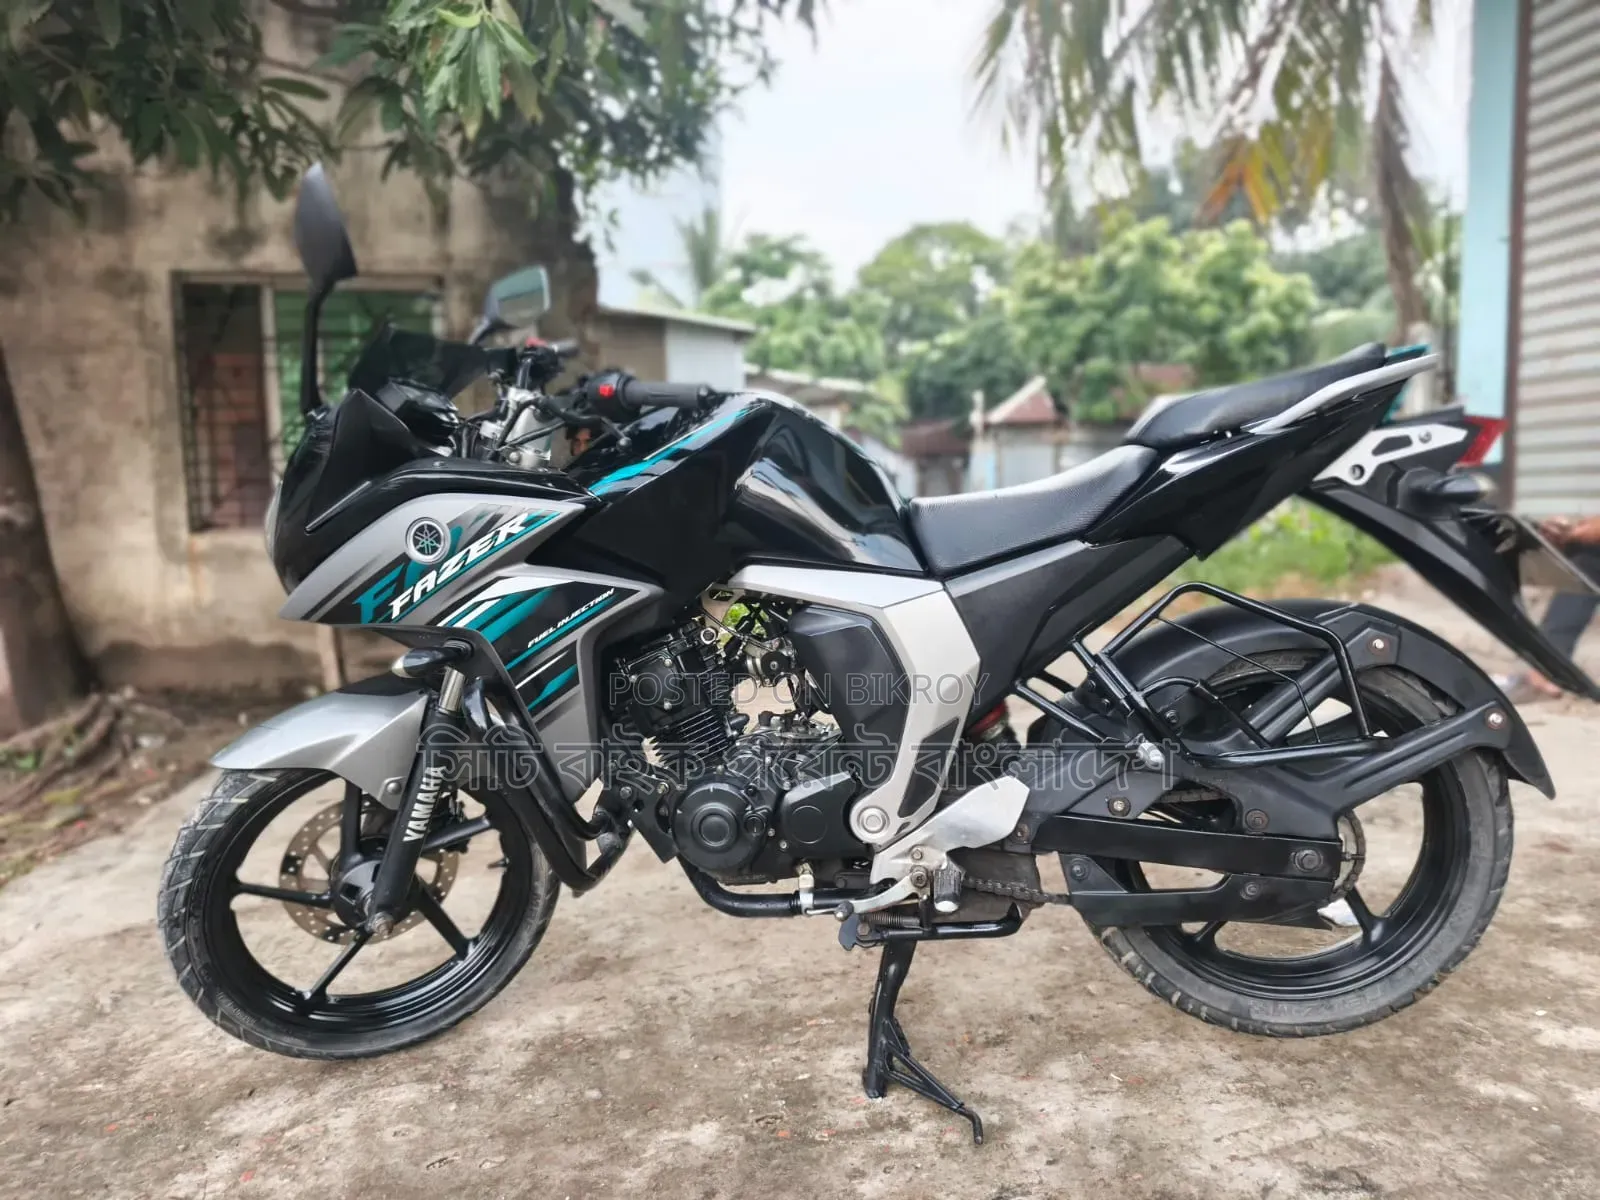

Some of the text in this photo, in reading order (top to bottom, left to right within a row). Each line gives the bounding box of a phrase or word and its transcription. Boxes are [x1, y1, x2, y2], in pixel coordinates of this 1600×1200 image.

[388, 512, 529, 619] FAZER
[527, 587, 615, 649] FUEL INJECTION
[403, 766, 447, 842] YAMAHA
